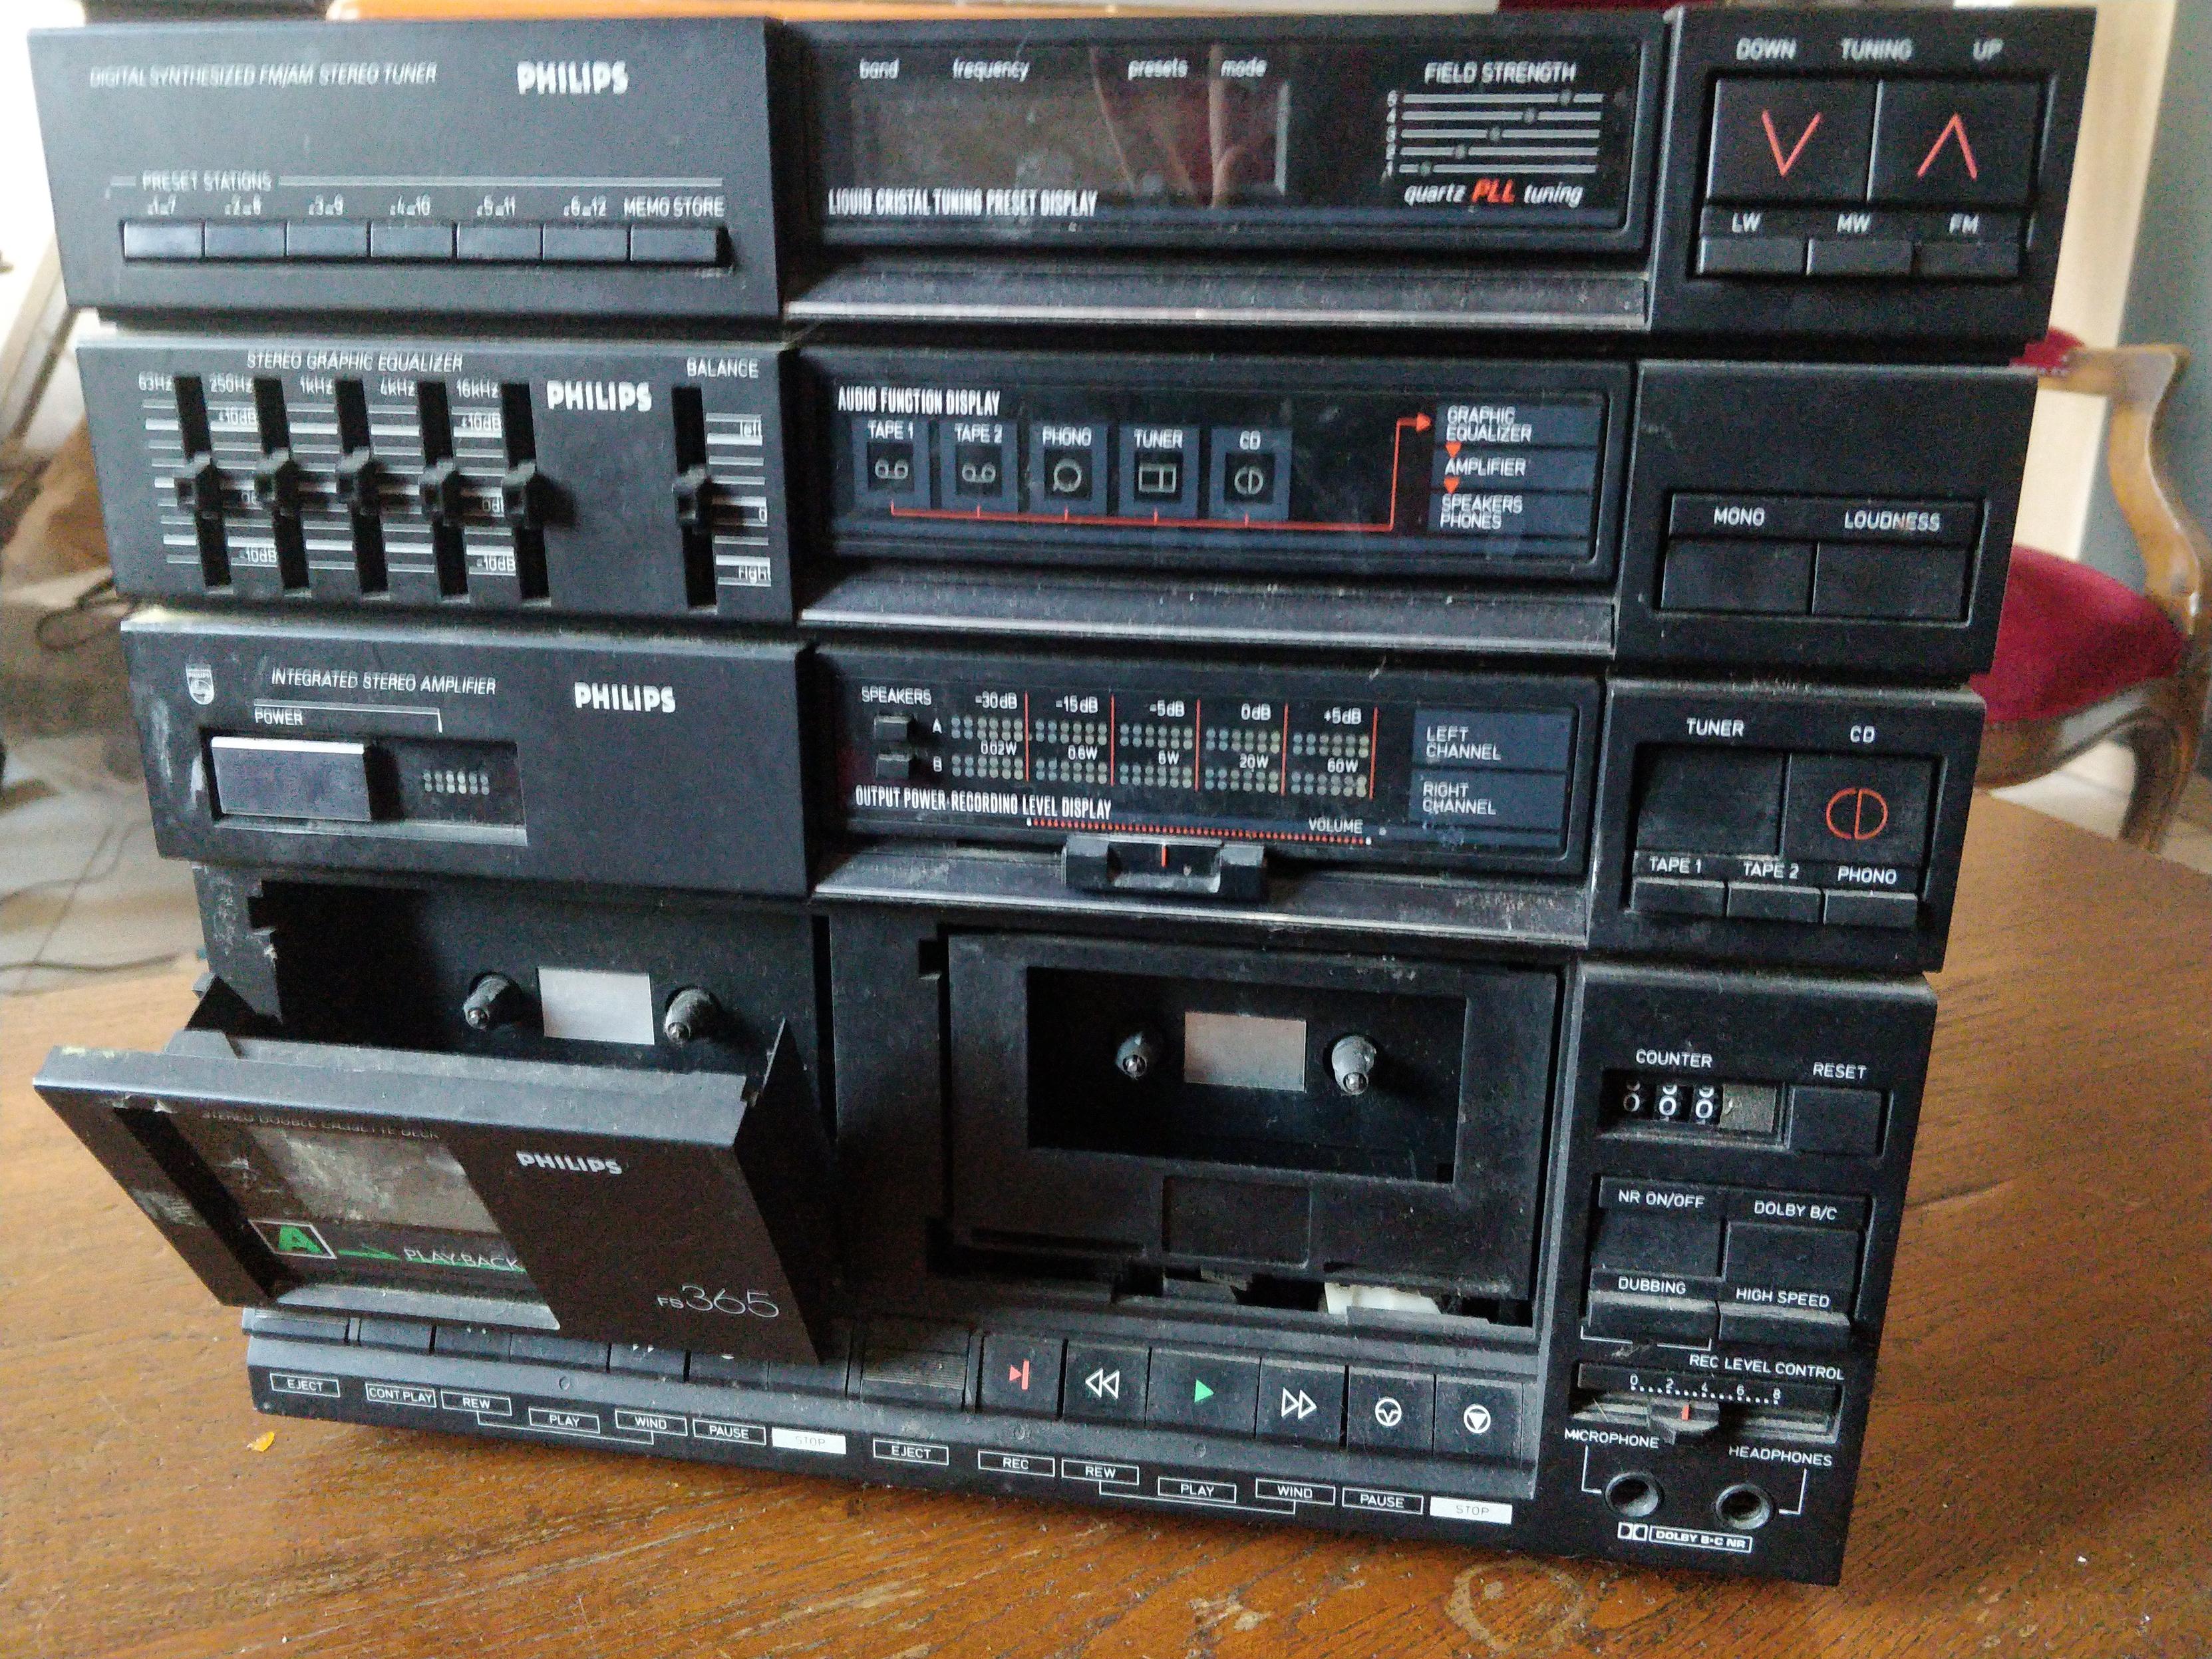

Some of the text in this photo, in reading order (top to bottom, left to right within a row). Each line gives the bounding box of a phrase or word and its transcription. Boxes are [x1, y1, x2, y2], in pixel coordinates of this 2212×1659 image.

[1736, 37, 1796, 61] DOWN
[1841, 38, 1914, 61] TUNING
[1973, 39, 2003, 61] UP
[90, 61, 437, 87] DIGITAL SYNTHESIZED FM/AM STEREO TUNER
[518, 61, 629, 94] PHILIPS
[860, 58, 899, 80] band
[953, 57, 1030, 82] frequency
[1127, 57, 1188, 81] presets
[1220, 57, 1267, 78] mode
[1424, 61, 1578, 84] FIELD STRENGTH
[142, 169, 272, 192] PRESET STATIONS
[828, 188, 873, 216] LIQUID
[932, 188, 983, 216] TUNING
[986, 188, 1038, 217] PRESET
[1039, 189, 1098, 218] DISPLAY
[1404, 178, 1585, 208] quartz PLL tuning
[623, 195, 725, 218] MEMO STORE
[1731, 212, 1762, 233] LW
[1837, 213, 1871, 233] MW
[1949, 213, 1980, 235] FM
[247, 351, 464, 373] STEREO GRAPHIC EQUALIZER
[686, 357, 759, 378] BALANCE
[138, 371, 173, 392] 63Hz
[299, 377, 334, 395] 1kHz
[379, 378, 416, 397] 4kHz
[456, 378, 501, 398] 16kHz
[546, 379, 653, 412] PHILIPS
[838, 386, 1001, 417] AUDIO FUNCTION DISPLAY
[1447, 405, 1516, 424] GRAPHIC
[868, 419, 914, 440] TAPE 1
[954, 422, 1003, 444] TAPE 2
[1042, 426, 1092, 447] PHONO
[1134, 428, 1184, 450] TUNER
[1446, 423, 1532, 443] EQUALIZER
[1239, 430, 1261, 450] CD
[1444, 457, 1527, 477] AMPLIFIER
[1441, 493, 1523, 514] SPEAKERS
[1440, 510, 1502, 530] PHONES
[1713, 506, 1766, 528] MONO
[1844, 509, 1941, 533] LOUDNESS
[271, 666, 497, 696] INTEGRATED STEREO AMPLIFIER
[574, 681, 676, 713] PHILIPS
[862, 686, 932, 706] SPEAKERS
[255, 707, 304, 727] POWER
[931, 718, 943, 734] A
[1426, 724, 1470, 743] LEFT
[1686, 717, 1746, 738] TUNER
[1850, 724, 1876, 744] CD
[1426, 742, 1502, 761] CHANNEL
[933, 756, 943, 773] B
[1422, 780, 1470, 798] RIGHT
[855, 784, 902, 808] OUTPUT
[1022, 794, 1058, 818] LEVEL
[1061, 796, 1113, 820] DISPLAY
[1422, 797, 1497, 816] CHANNEL
[1308, 817, 1364, 835] VOLUME
[1649, 855, 1702, 873] TAPE 1
[1744, 861, 1800, 879] TAPE 2
[1837, 865, 1897, 885] PHONO
[1635, 1048, 1713, 1068] COUNTER
[1813, 1061, 1867, 1080] RESET
[516, 1149, 622, 1175] PHILIPS
[1618, 1189, 1706, 1209] NR ON/OFF
[1754, 1200, 1837, 1221] DOLBY B/C
[279, 1225, 323, 1255] A
[1618, 1275, 1686, 1295] DUBBING
[1736, 1287, 1830, 1308] HIGH SPEED
[1689, 1353, 1845, 1382] REC LEVEL CONTROL
[287, 1378, 324, 1393] EJECT
[369, 1386, 432, 1404] CONT PLAY
[1630, 1373, 1782, 1400] 0 2 4 6 8
[462, 1396, 491, 1410] REW
[549, 1414, 581, 1428] PLAY
[633, 1416, 668, 1431] WIND
[709, 1424, 750, 1440] PAUSE
[794, 1434, 826, 1447] STOP
[1564, 1427, 1660, 1449] MICROPHONE
[891, 1444, 931, 1460] EJECT
[1728, 1444, 1833, 1467] HEADPHONES
[1003, 1456, 1030, 1471] REC
[1084, 1465, 1117, 1479] REW
[1180, 1483, 1215, 1497] PLAY
[1277, 1484, 1313, 1499] WIND
[1360, 1493, 1405, 1509] PAUSE
[1456, 1504, 1490, 1517] STOP
[1655, 1530, 1698, 1543] DOLBY
[1726, 1539, 1746, 1549] NR
